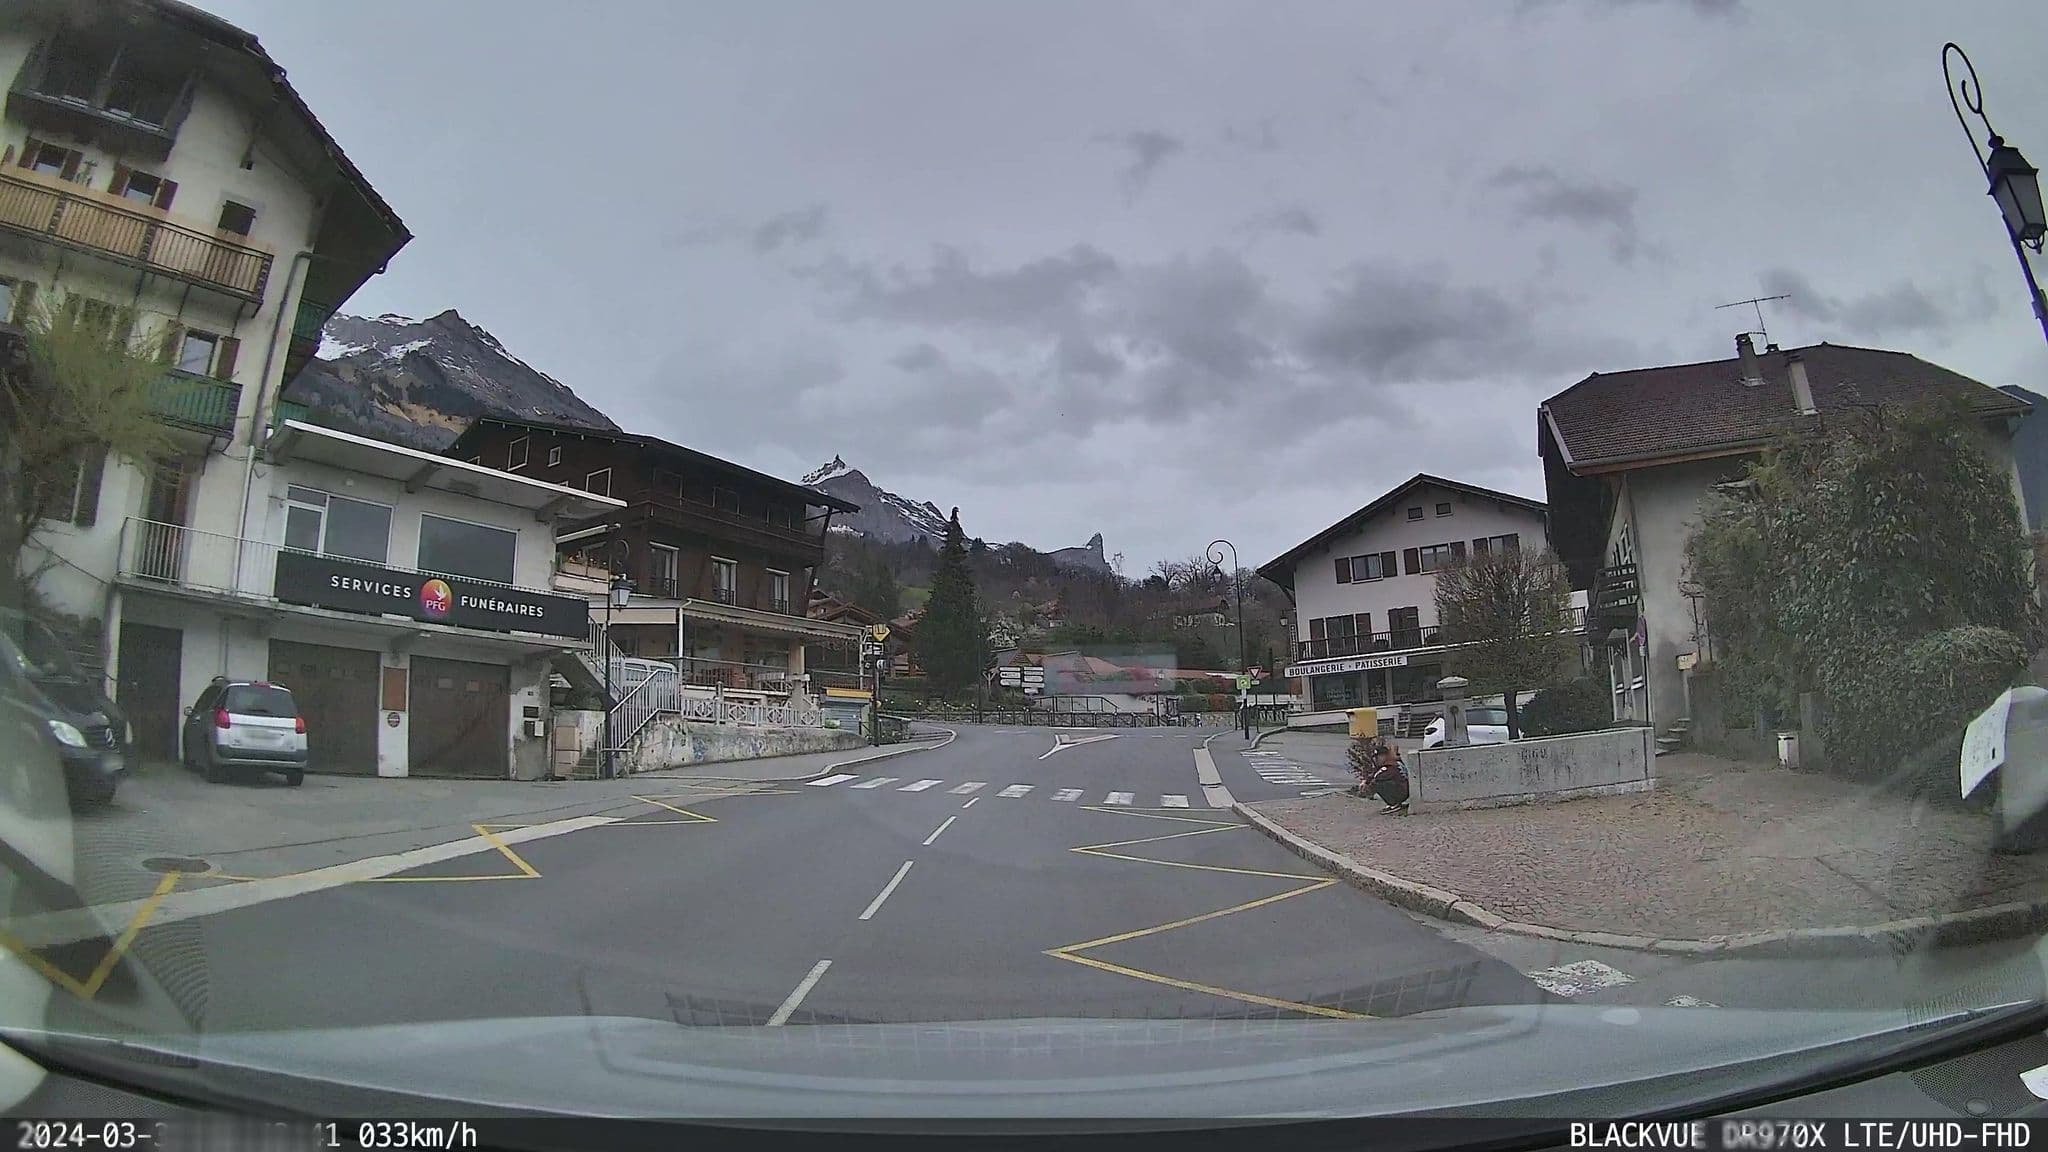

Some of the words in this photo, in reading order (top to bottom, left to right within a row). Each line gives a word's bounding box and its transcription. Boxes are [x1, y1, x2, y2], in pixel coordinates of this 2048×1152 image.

[330, 575, 412, 598] SERVICES
[461, 595, 544, 618] FUNÉRAIRES
[426, 600, 446, 611] PFG
[1289, 663, 1345, 677] BOULANGERIE
[1355, 656, 1403, 670] PATISSERIE
